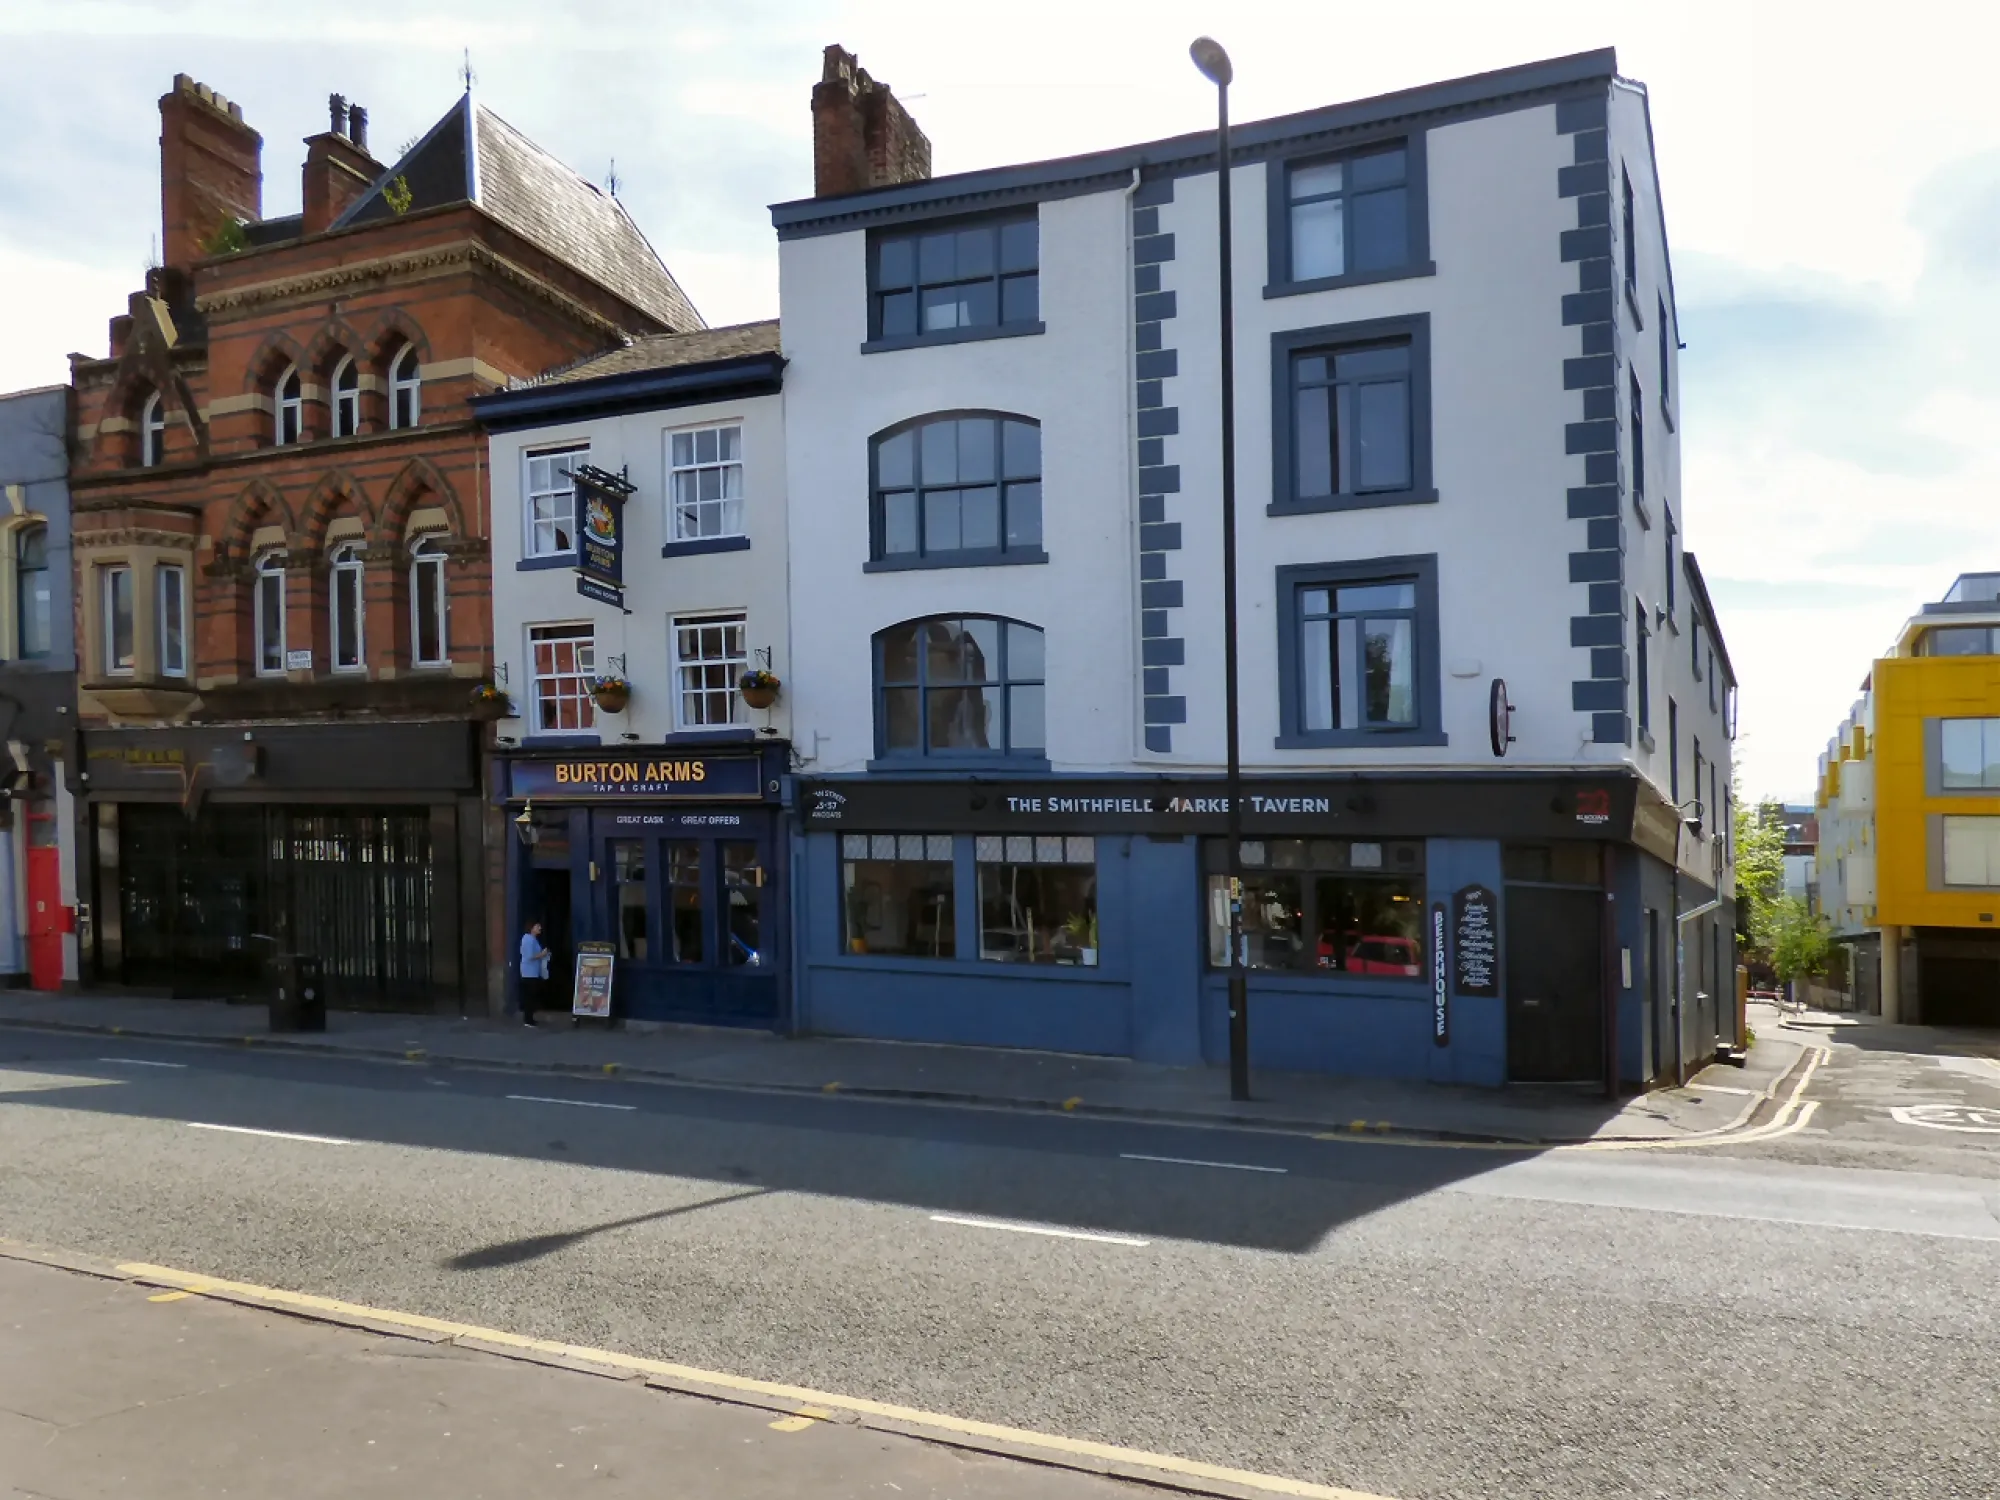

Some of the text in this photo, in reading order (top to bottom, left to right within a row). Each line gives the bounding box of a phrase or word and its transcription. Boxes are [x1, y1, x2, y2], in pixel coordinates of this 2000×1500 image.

[555, 761, 706, 783] BURTON ARMS
[593, 784, 614, 792] TAP
[632, 783, 670, 792] CRAFT
[1007, 797, 1042, 813] THE
[1164, 797, 1244, 813] MARKE
[1251, 796, 1330, 813] TAVERN
[616, 816, 740, 825] GREAT CASK GREAT OFFERS
[1435, 911, 1446, 1036] BEERHOUSE
